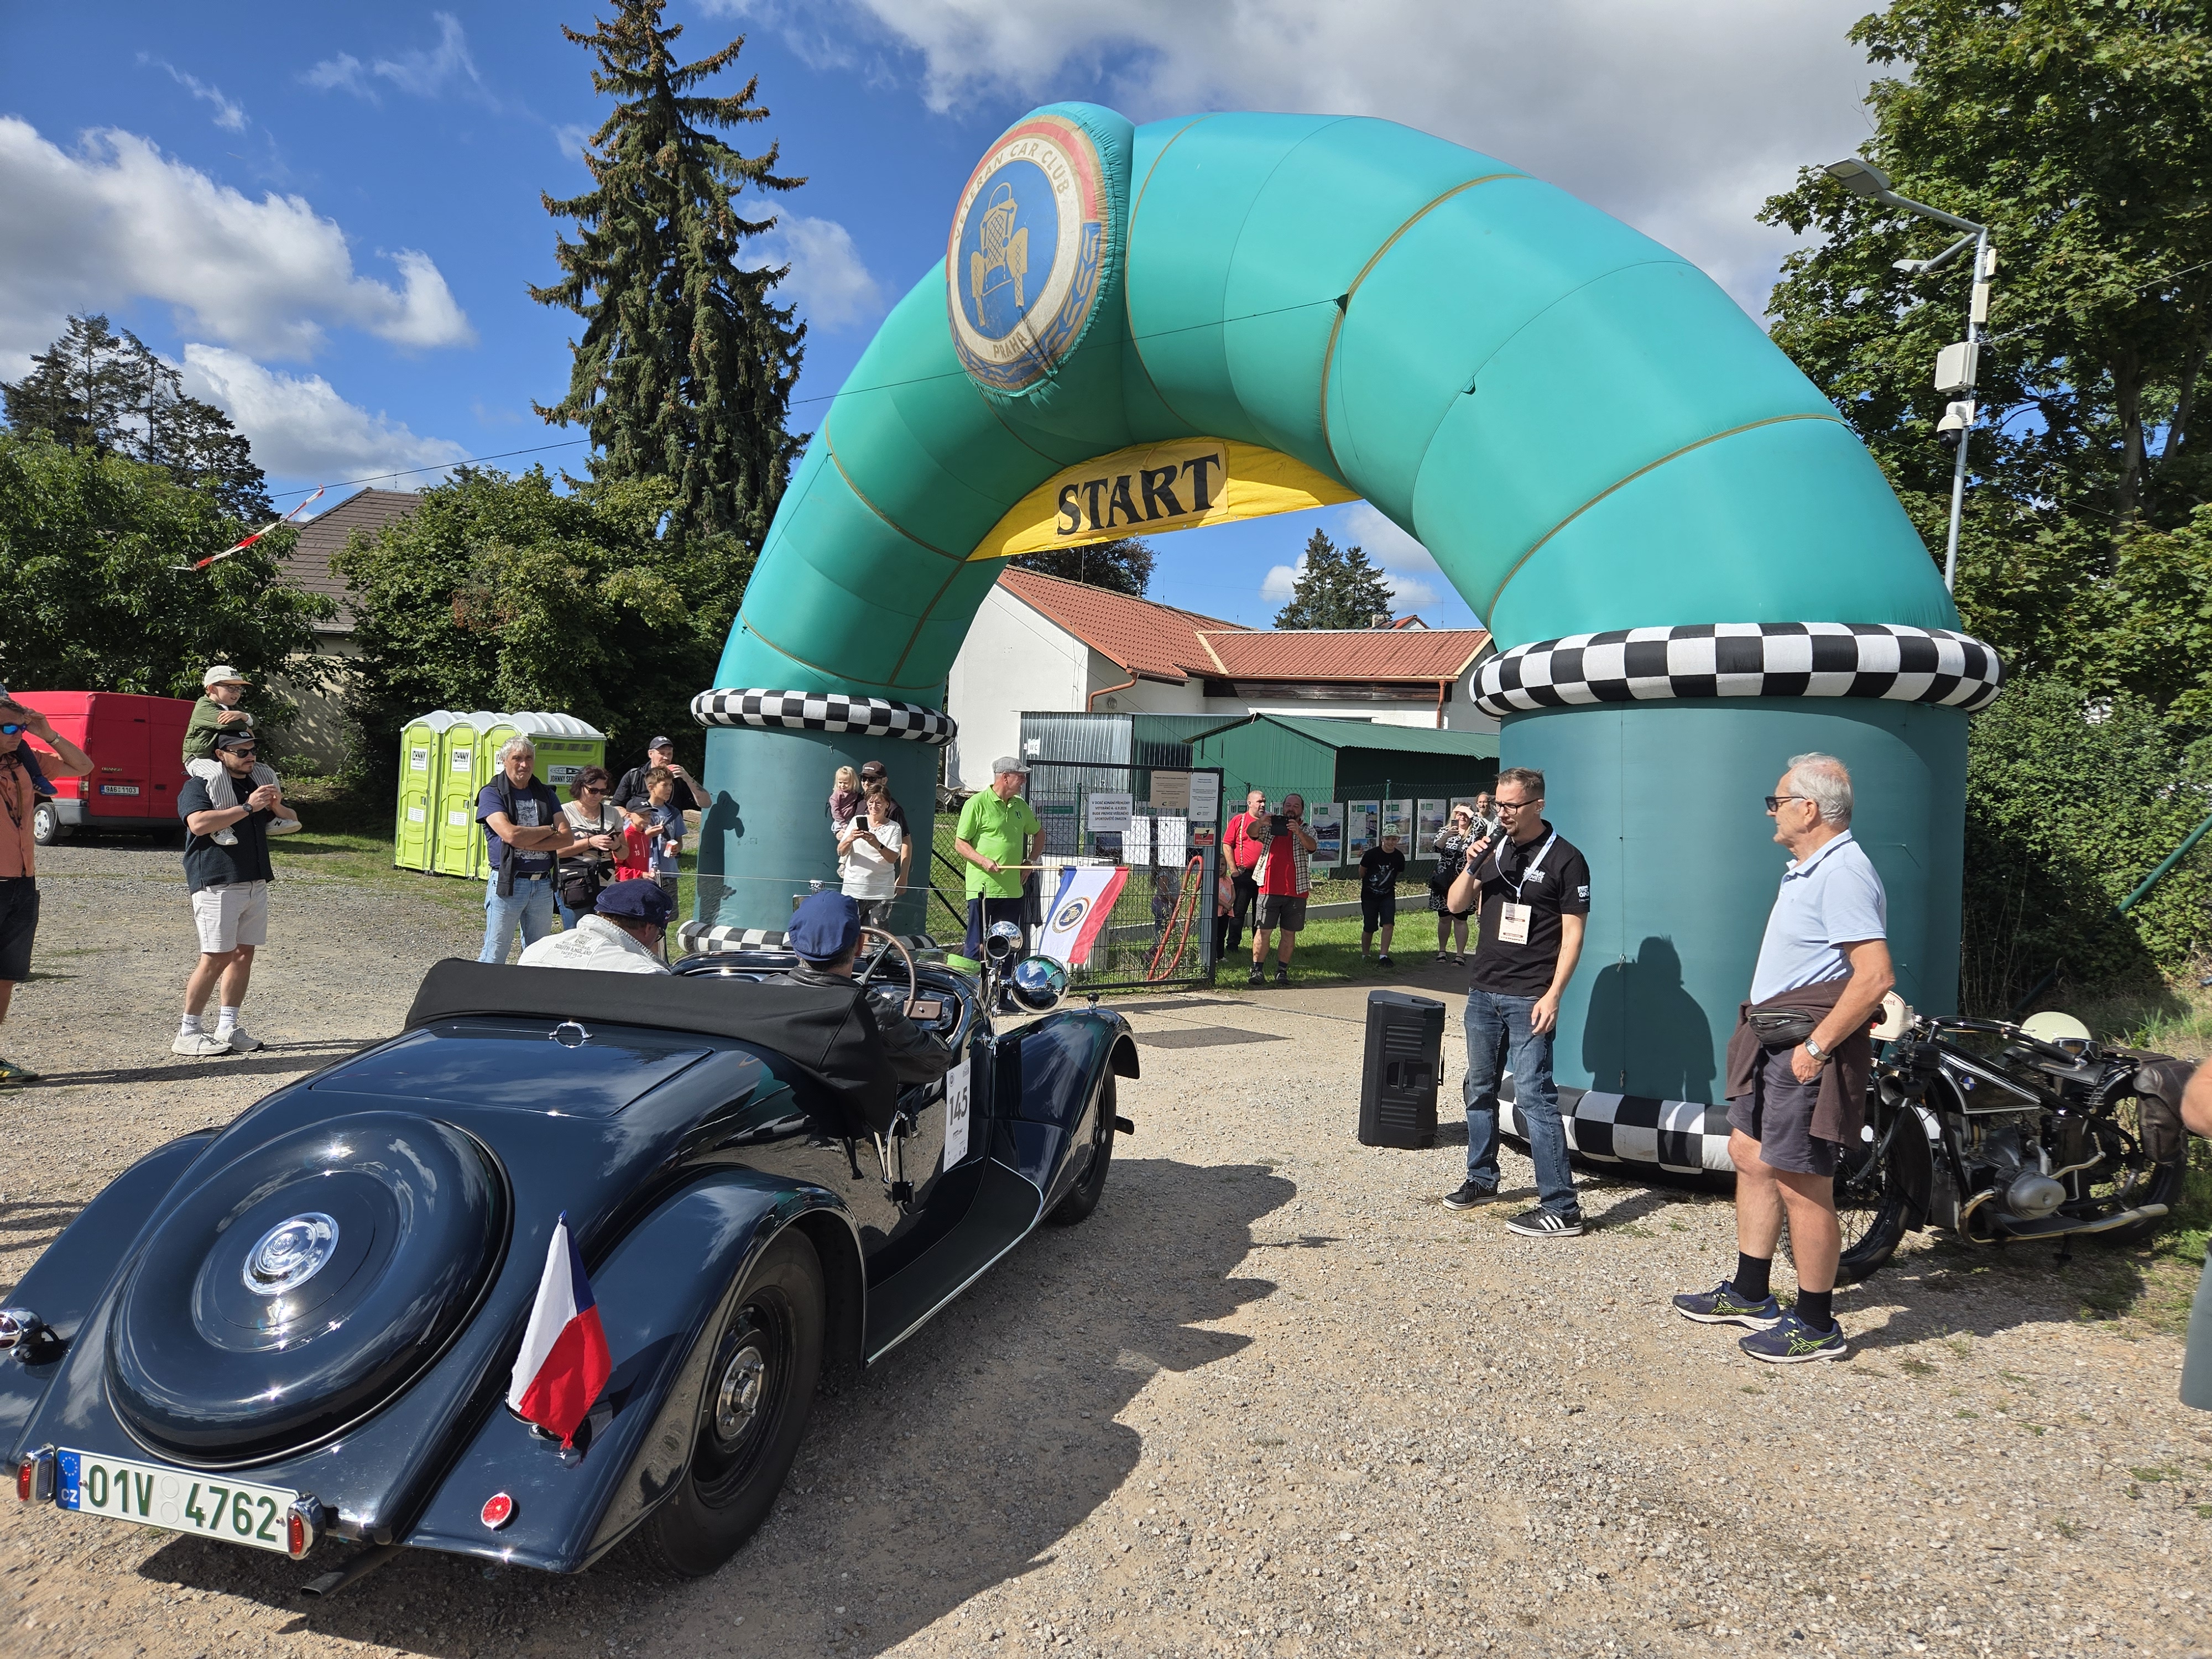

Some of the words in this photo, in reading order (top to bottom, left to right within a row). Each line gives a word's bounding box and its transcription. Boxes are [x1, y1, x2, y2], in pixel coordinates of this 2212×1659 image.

[954, 153, 1004, 241] VETERAN
[1010, 142, 1039, 158] CAR
[1041, 150, 1070, 194] CLUB
[993, 331, 1028, 359] PRAHA
[1056, 452, 1220, 536] START
[550, 775, 565, 783] JOHNNY
[950, 1085, 968, 1126] 145
[61, 1488, 77, 1503] CZ
[88, 1464, 154, 1517] 01V
[185, 1482, 278, 1542] 4762
